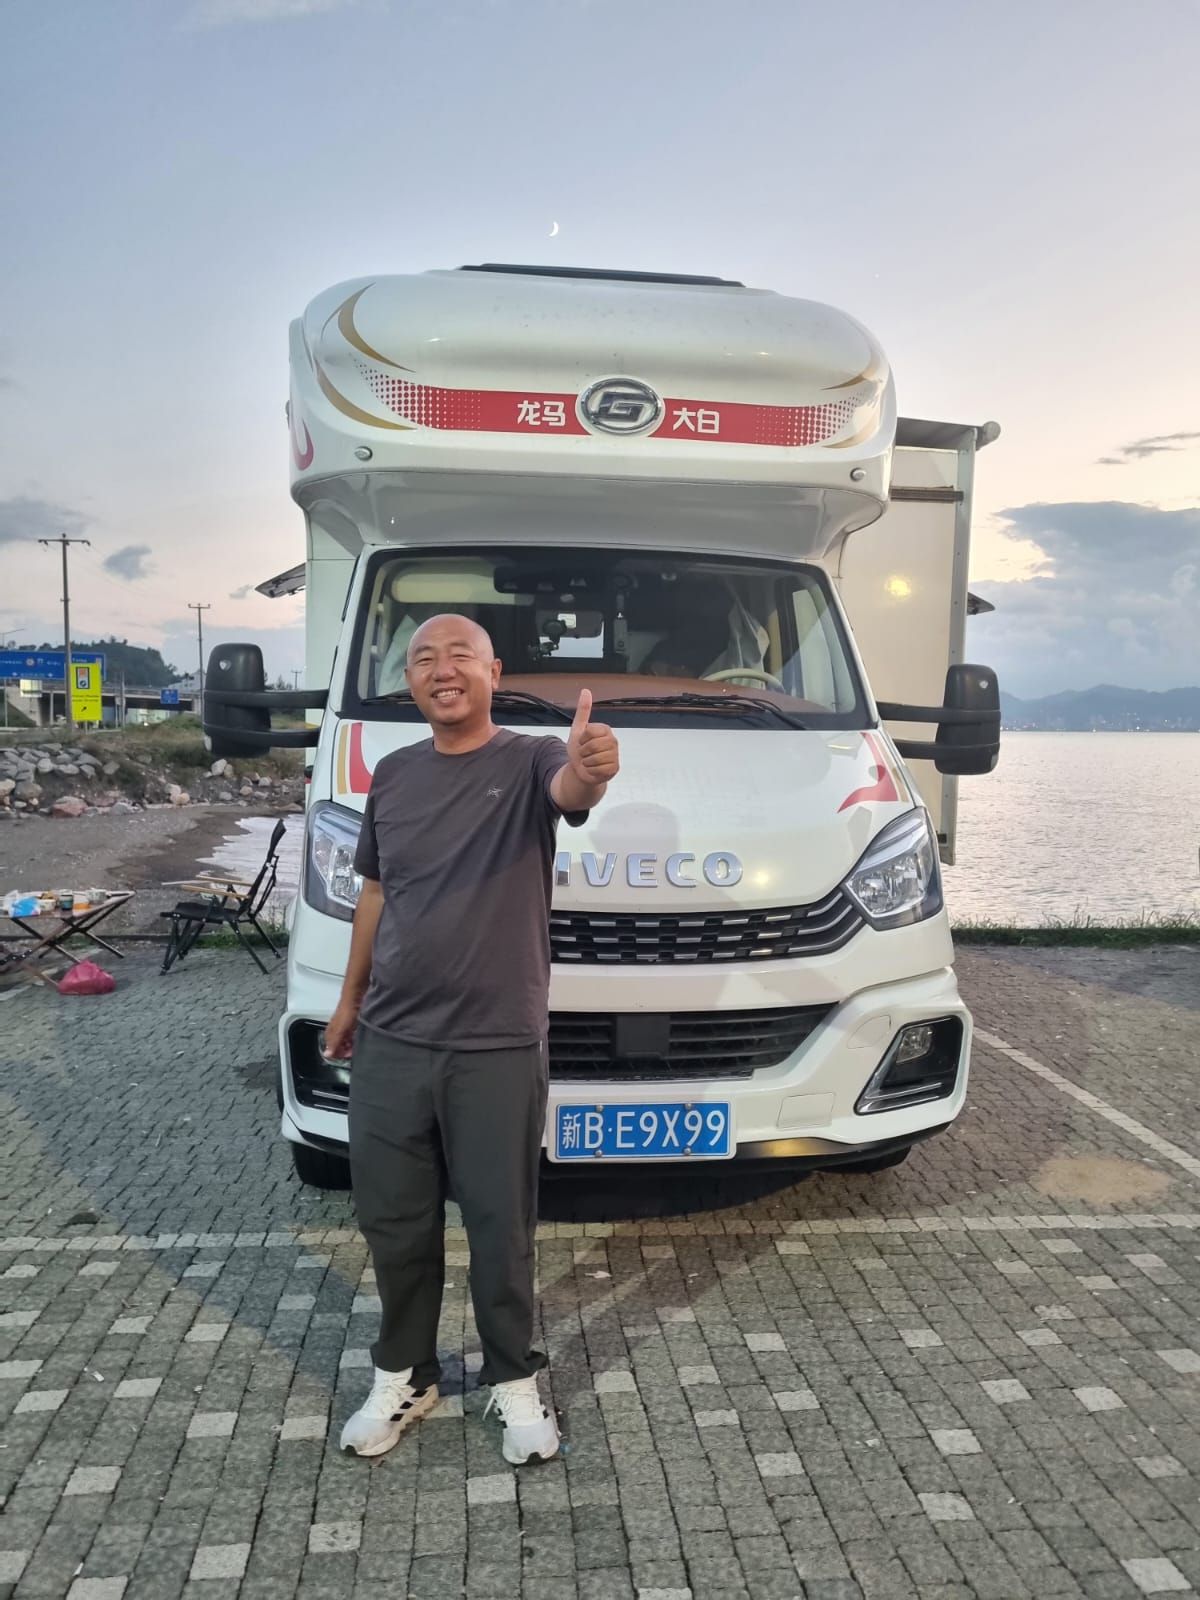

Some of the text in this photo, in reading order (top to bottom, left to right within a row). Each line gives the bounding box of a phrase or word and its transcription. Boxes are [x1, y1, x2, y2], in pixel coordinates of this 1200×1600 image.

[517, 400, 720, 434] 龙马 大白
[555, 851, 744, 888] IVECO
